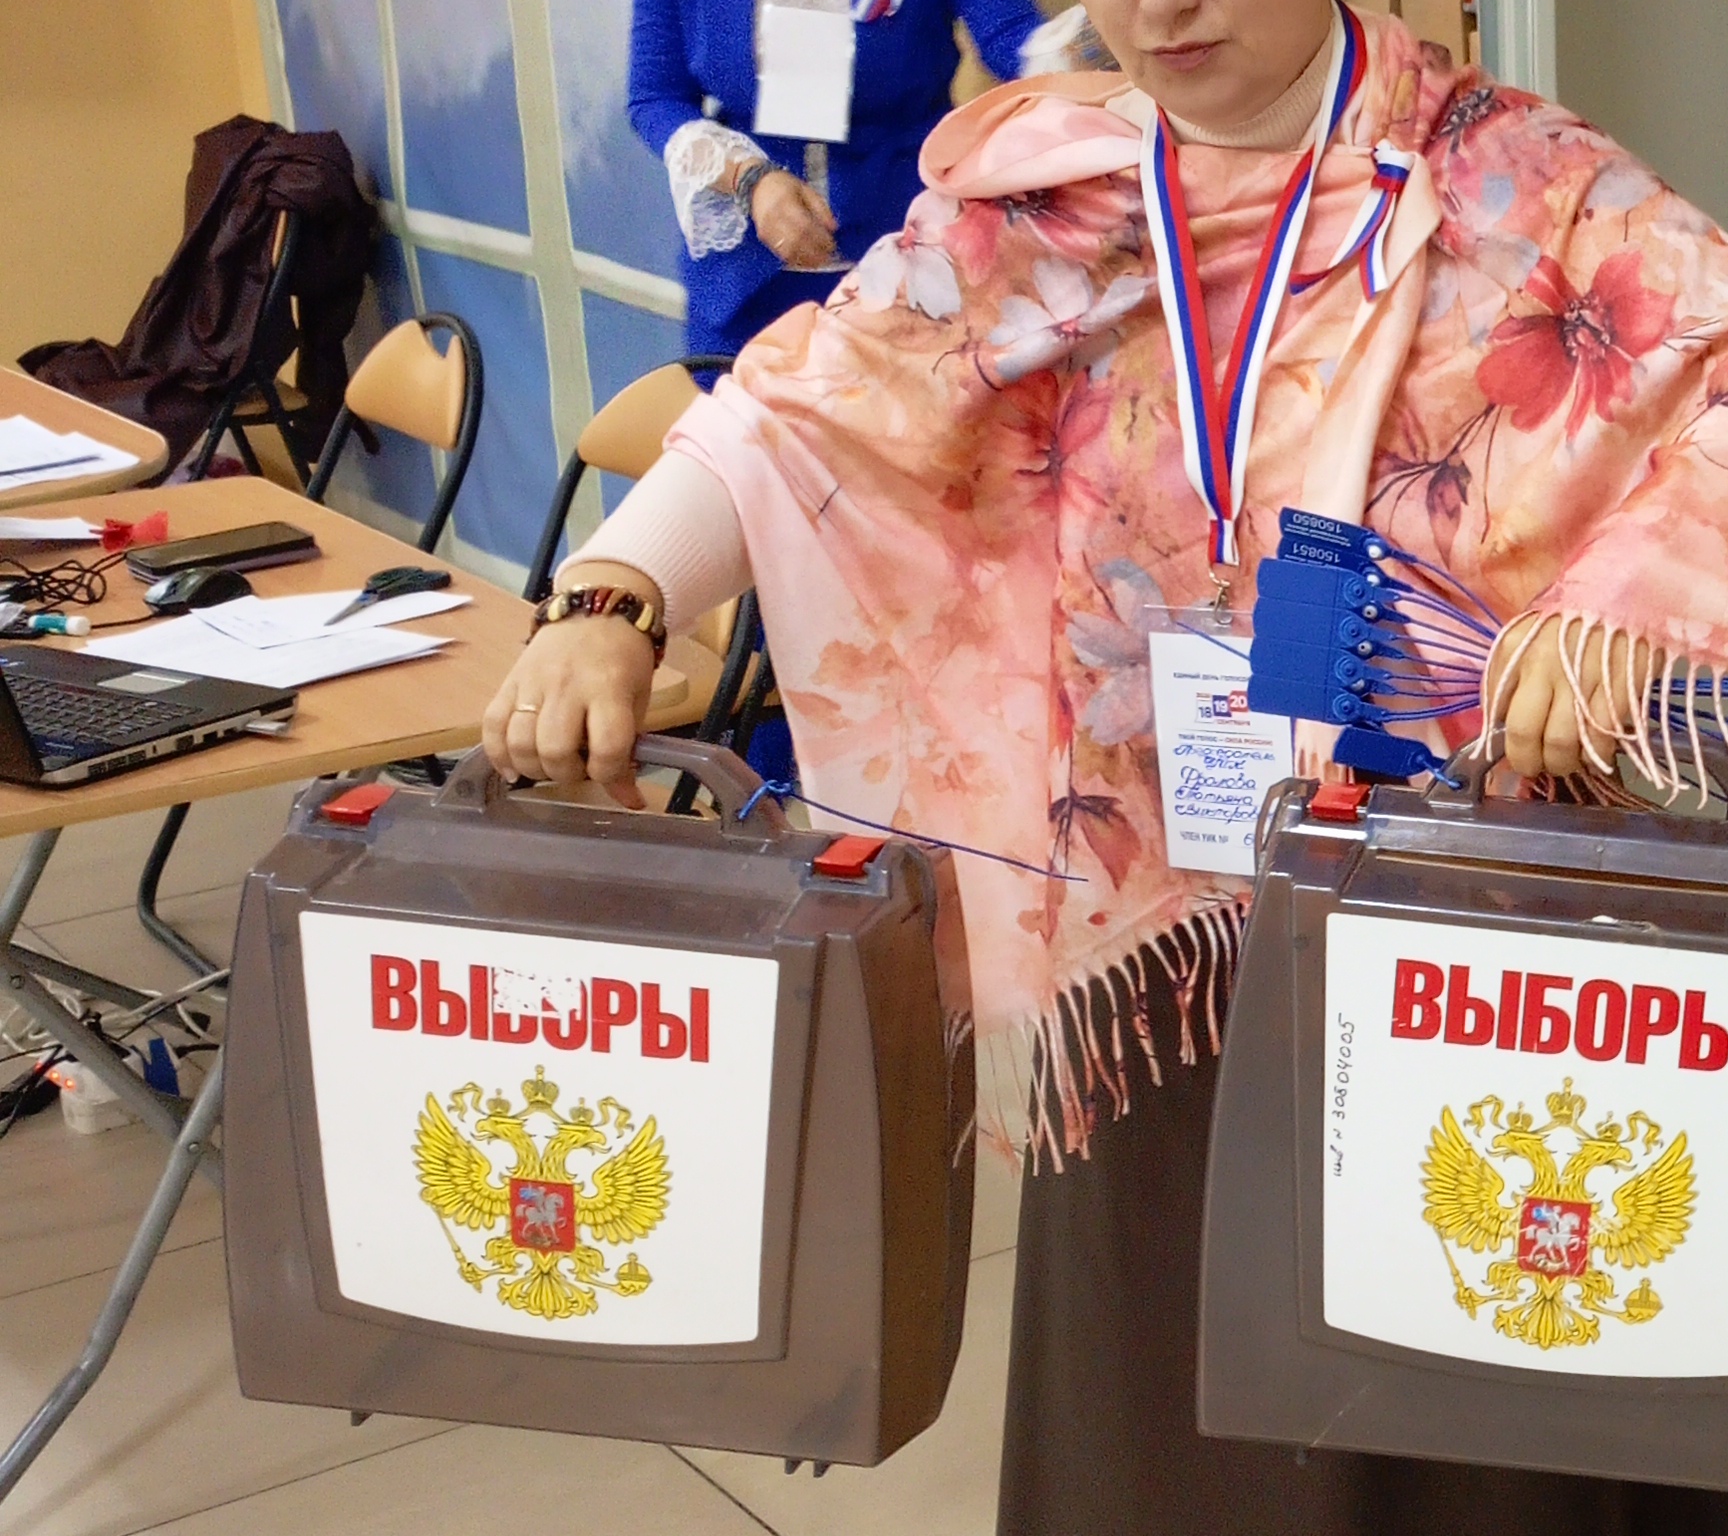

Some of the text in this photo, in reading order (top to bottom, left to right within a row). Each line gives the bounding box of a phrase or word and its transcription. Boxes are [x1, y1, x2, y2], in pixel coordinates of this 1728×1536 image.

[1292, 513, 1343, 534] 150850
[1292, 542, 1342, 564] 150851
[1198, 695, 1247, 718] 18 19 20
